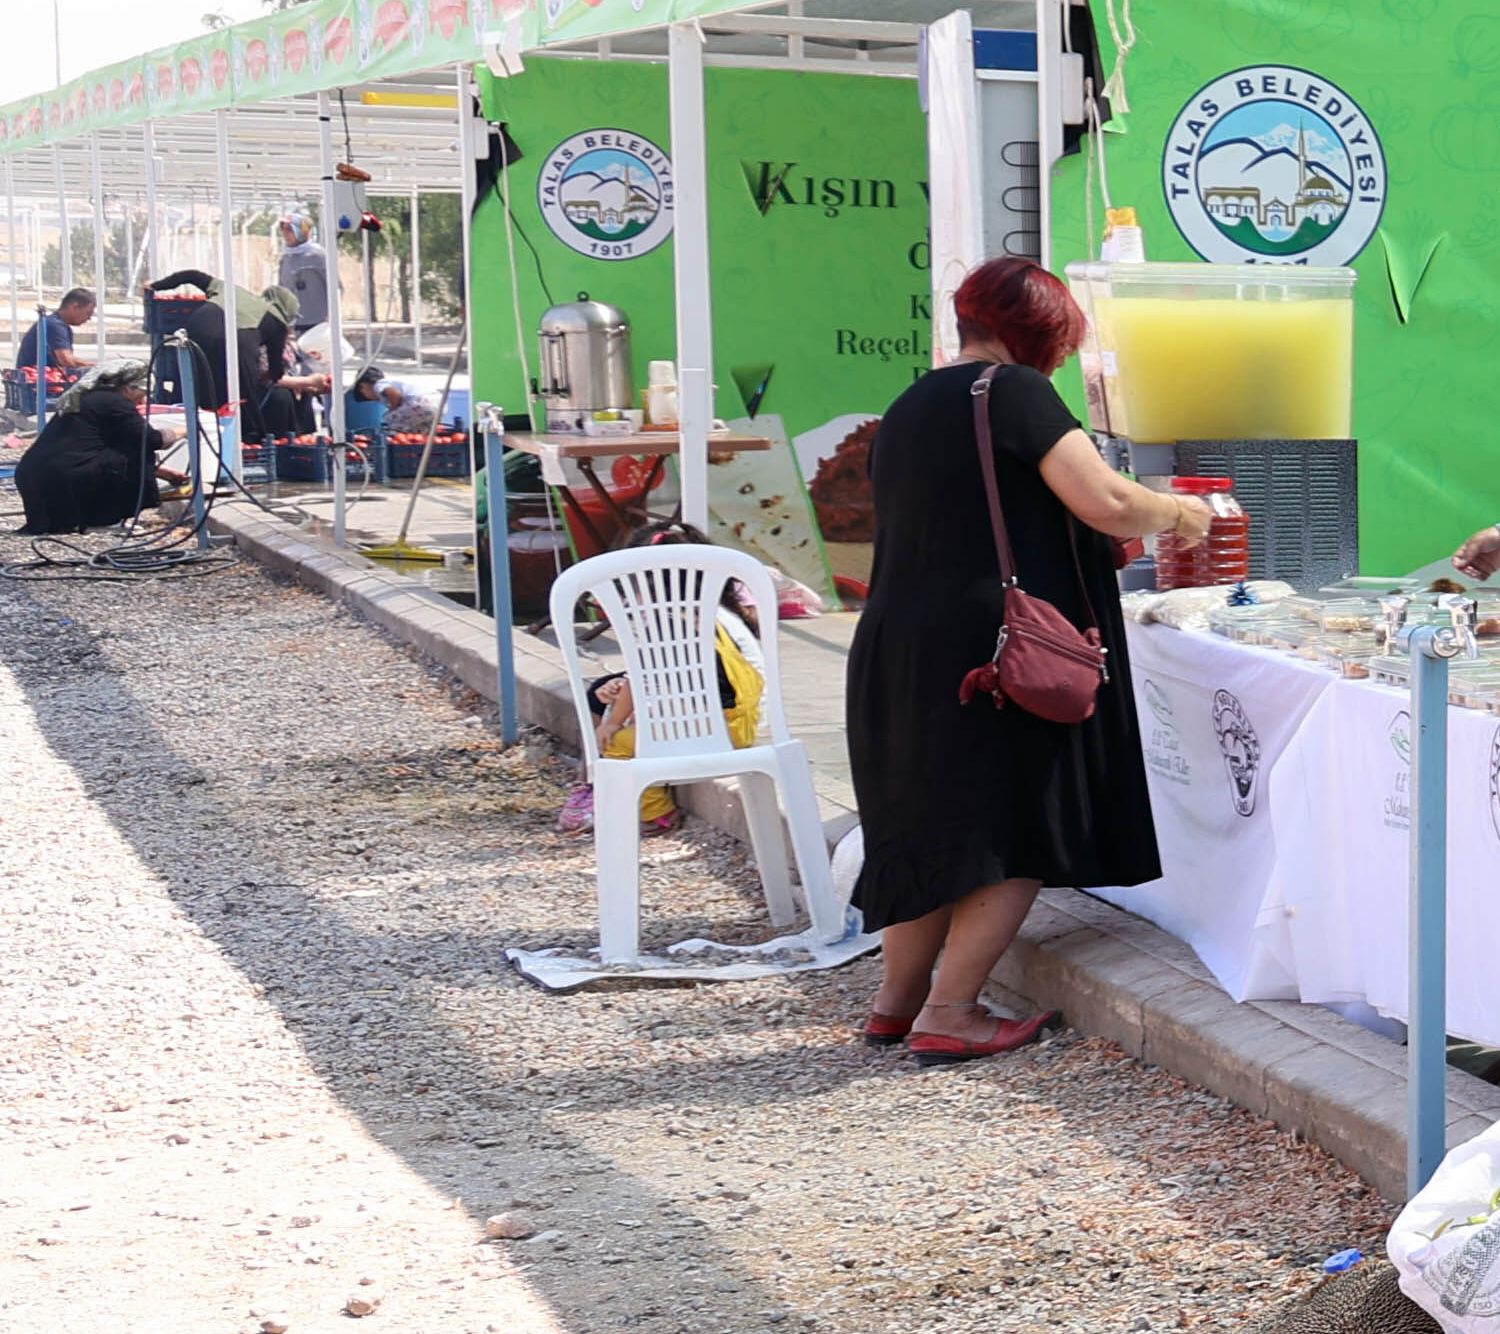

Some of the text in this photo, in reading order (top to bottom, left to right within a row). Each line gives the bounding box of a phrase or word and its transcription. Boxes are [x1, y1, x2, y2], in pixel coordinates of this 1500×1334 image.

[1170, 74, 1380, 207] TALAS BELEDİYESİ
[543, 146, 575, 209] TALAS
[756, 161, 898, 218] Kışın
[590, 242, 634, 256] 1907
